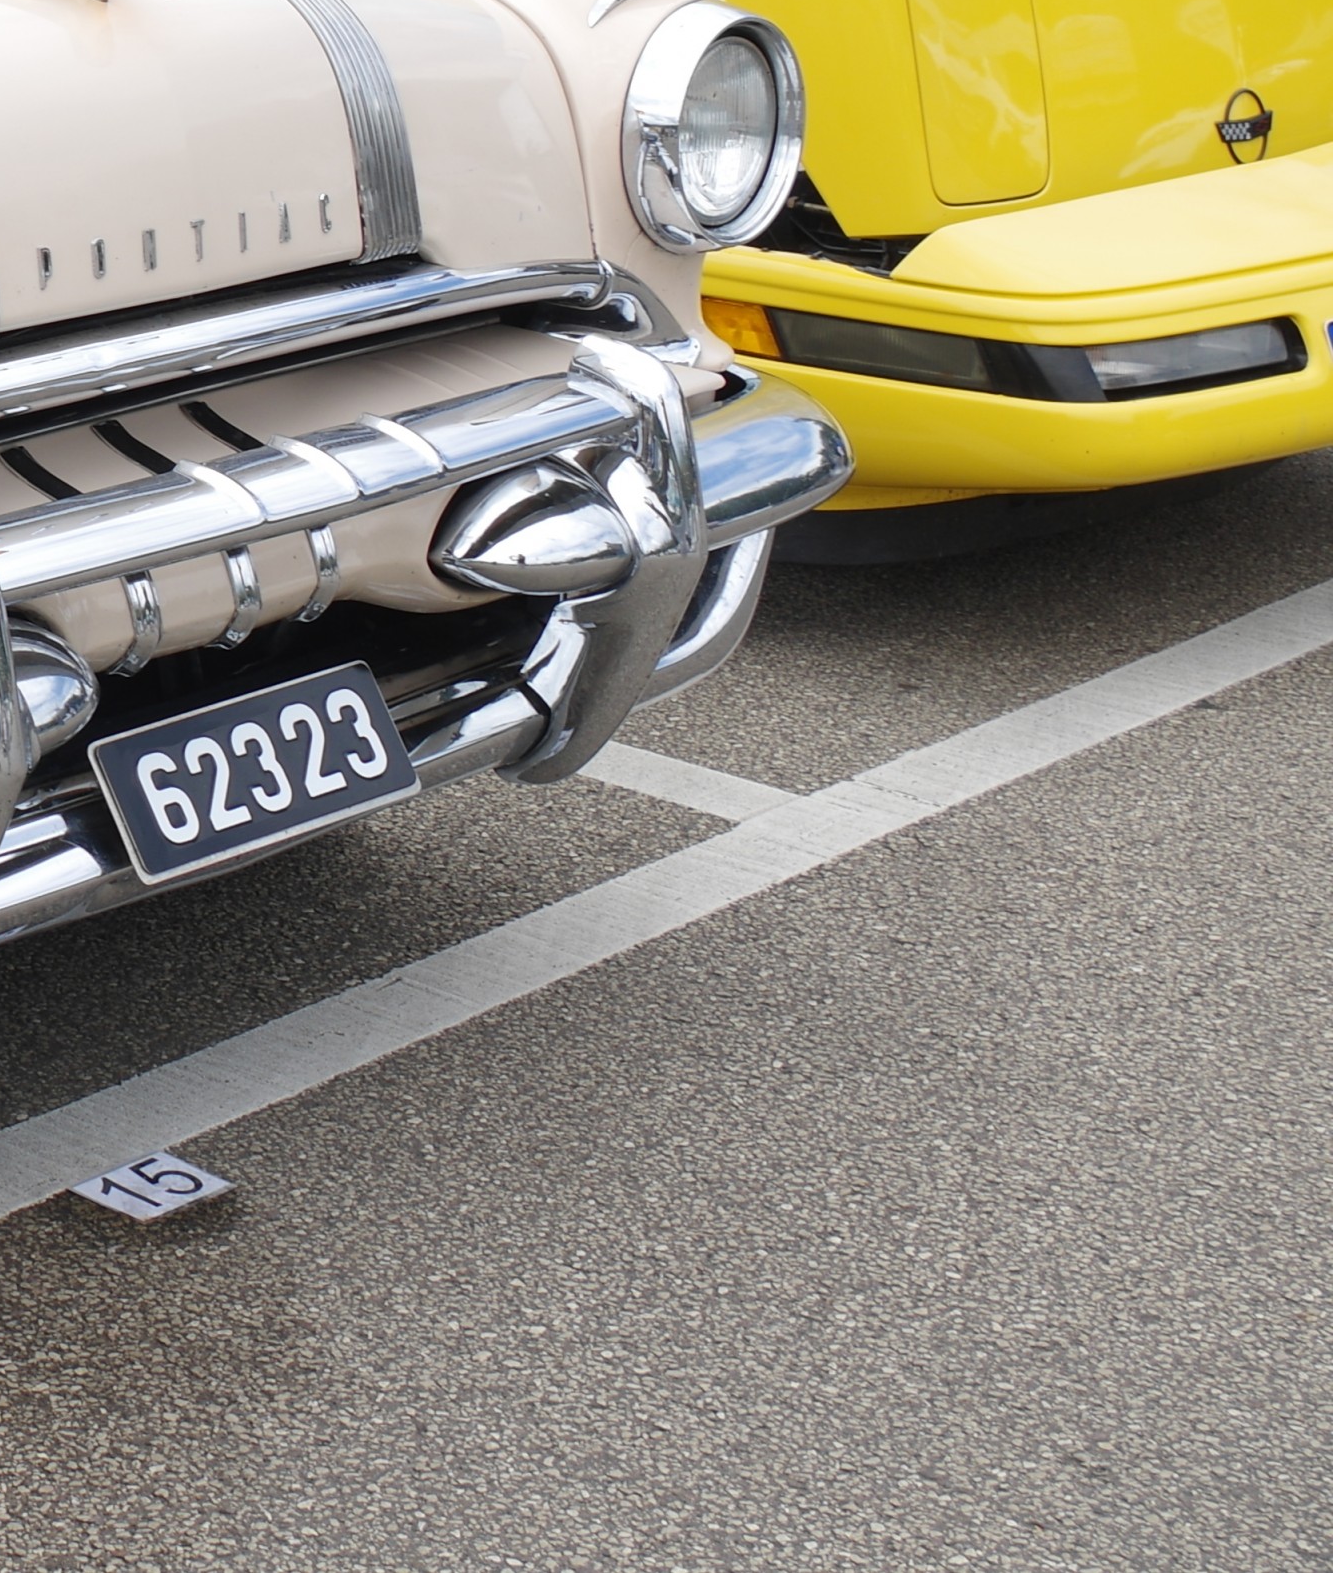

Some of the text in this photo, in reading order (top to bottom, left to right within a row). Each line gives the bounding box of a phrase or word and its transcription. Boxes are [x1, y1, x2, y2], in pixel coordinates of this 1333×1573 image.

[37, 192, 333, 291] PONTIAC
[136, 687, 389, 845] 62323
[100, 1157, 204, 1208] 15
